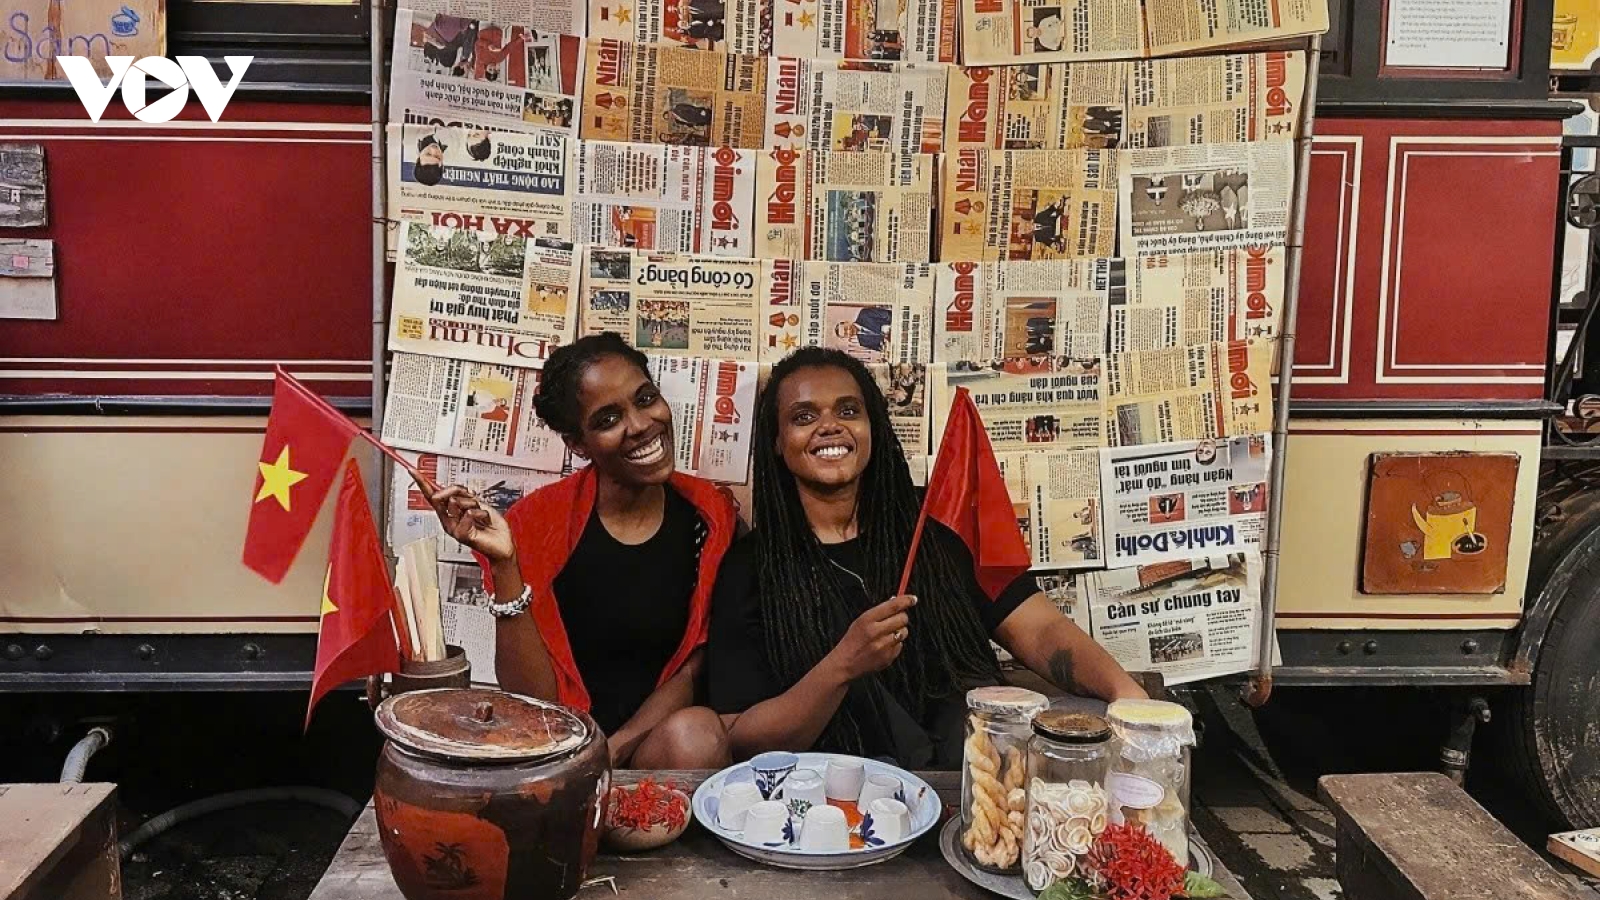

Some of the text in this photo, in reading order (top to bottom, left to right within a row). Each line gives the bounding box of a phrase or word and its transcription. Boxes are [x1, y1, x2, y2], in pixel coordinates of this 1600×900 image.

[595, 38, 619, 86] Nhân
[436, 82, 456, 93] Chính
[775, 65, 796, 114] Nhân
[425, 91, 442, 102] danh
[497, 142, 560, 161] thành công
[493, 156, 560, 174] khởi nghiệp
[955, 150, 976, 192] Nhân
[1002, 150, 1012, 181] Campuchia
[1084, 164, 1100, 178] sản
[442, 168, 481, 182] NGHIỆP
[482, 172, 509, 186] THẤT
[541, 178, 560, 189] LAO
[1215, 234, 1234, 243] Chính
[638, 265, 753, 289] Có công bằng?
[769, 260, 790, 306] Nhân
[430, 298, 444, 314] trị
[447, 303, 465, 317] giá
[467, 305, 489, 321] huy
[809, 298, 820, 320] suốt
[492, 309, 519, 324] Phát
[808, 322, 819, 338] tập
[1030, 375, 1098, 390] của người dân
[975, 390, 1098, 406] Vượt quá khả năng chi trả
[1114, 458, 1190, 478] tìm người tài
[1203, 468, 1233, 482] Ngân
[1170, 472, 1199, 487] hàng
[1108, 588, 1241, 620] Cần sự chung tay
